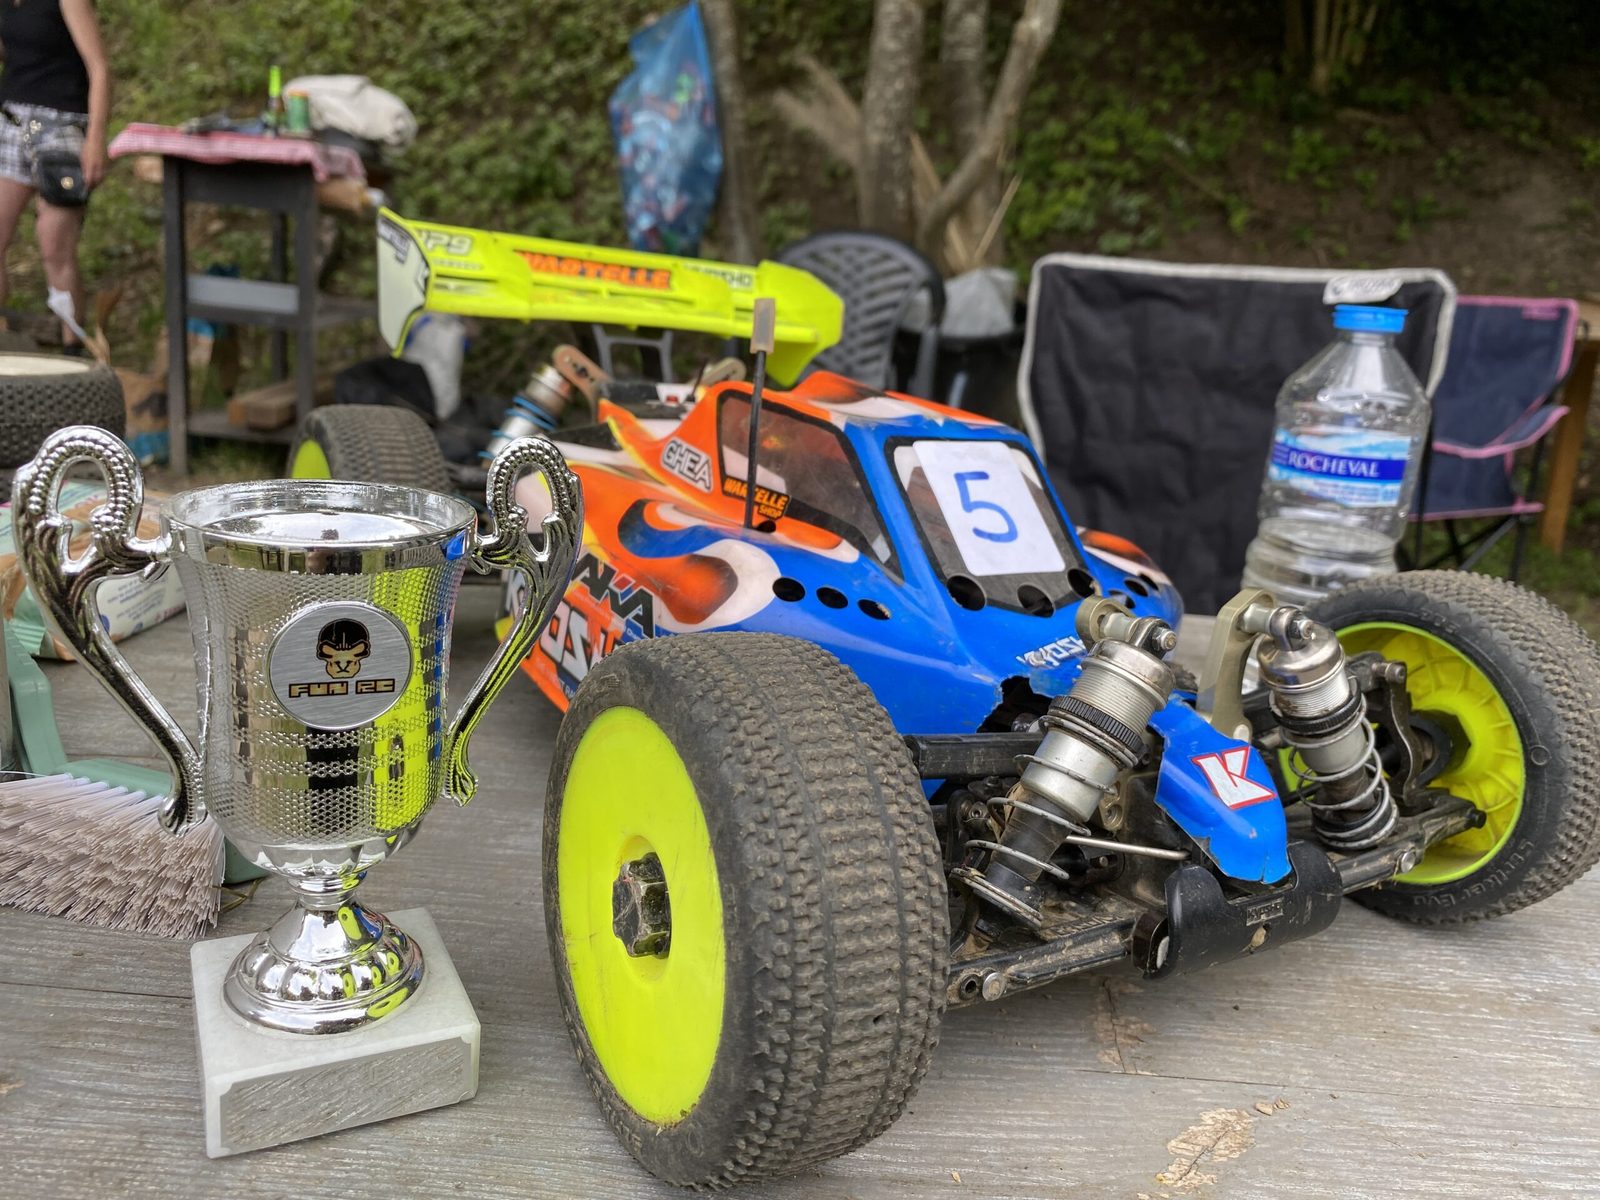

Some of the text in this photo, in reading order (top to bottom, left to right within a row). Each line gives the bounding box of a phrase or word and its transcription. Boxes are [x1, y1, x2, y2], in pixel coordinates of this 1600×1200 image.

[662, 438, 713, 491] GHEA
[1288, 451, 1380, 478] ROCHEVAL
[953, 471, 1018, 543] 5
[289, 678, 395, 698] FUN RC
